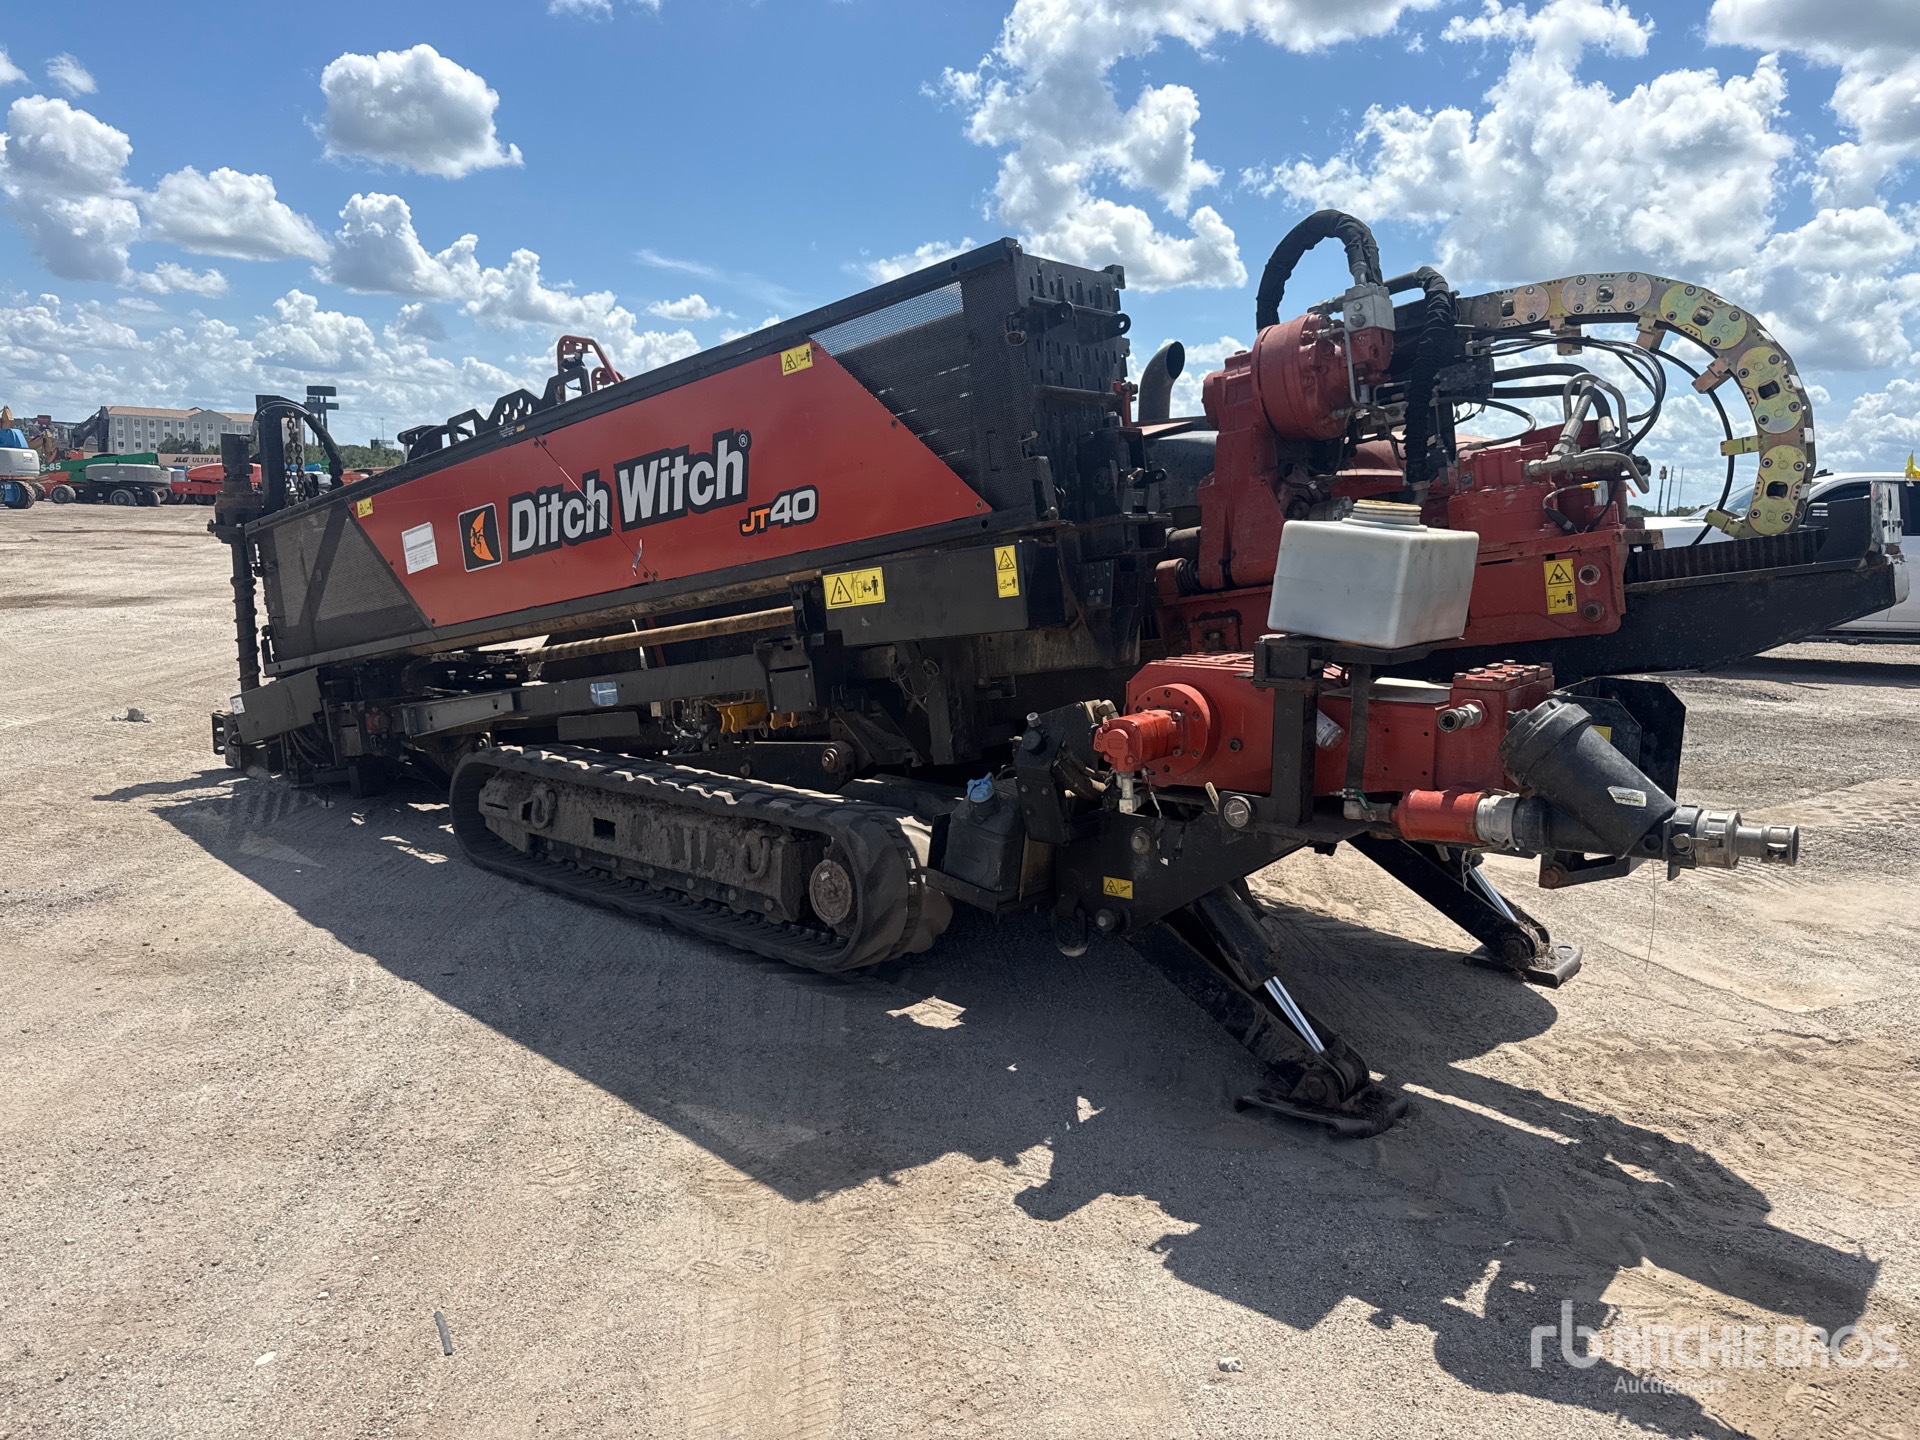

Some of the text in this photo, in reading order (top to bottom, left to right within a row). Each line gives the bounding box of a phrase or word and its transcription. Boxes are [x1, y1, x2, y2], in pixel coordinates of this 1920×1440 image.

[40, 462, 61, 472] S-85
[511, 478, 609, 553] Ditch
[741, 489, 816, 533] JT40
